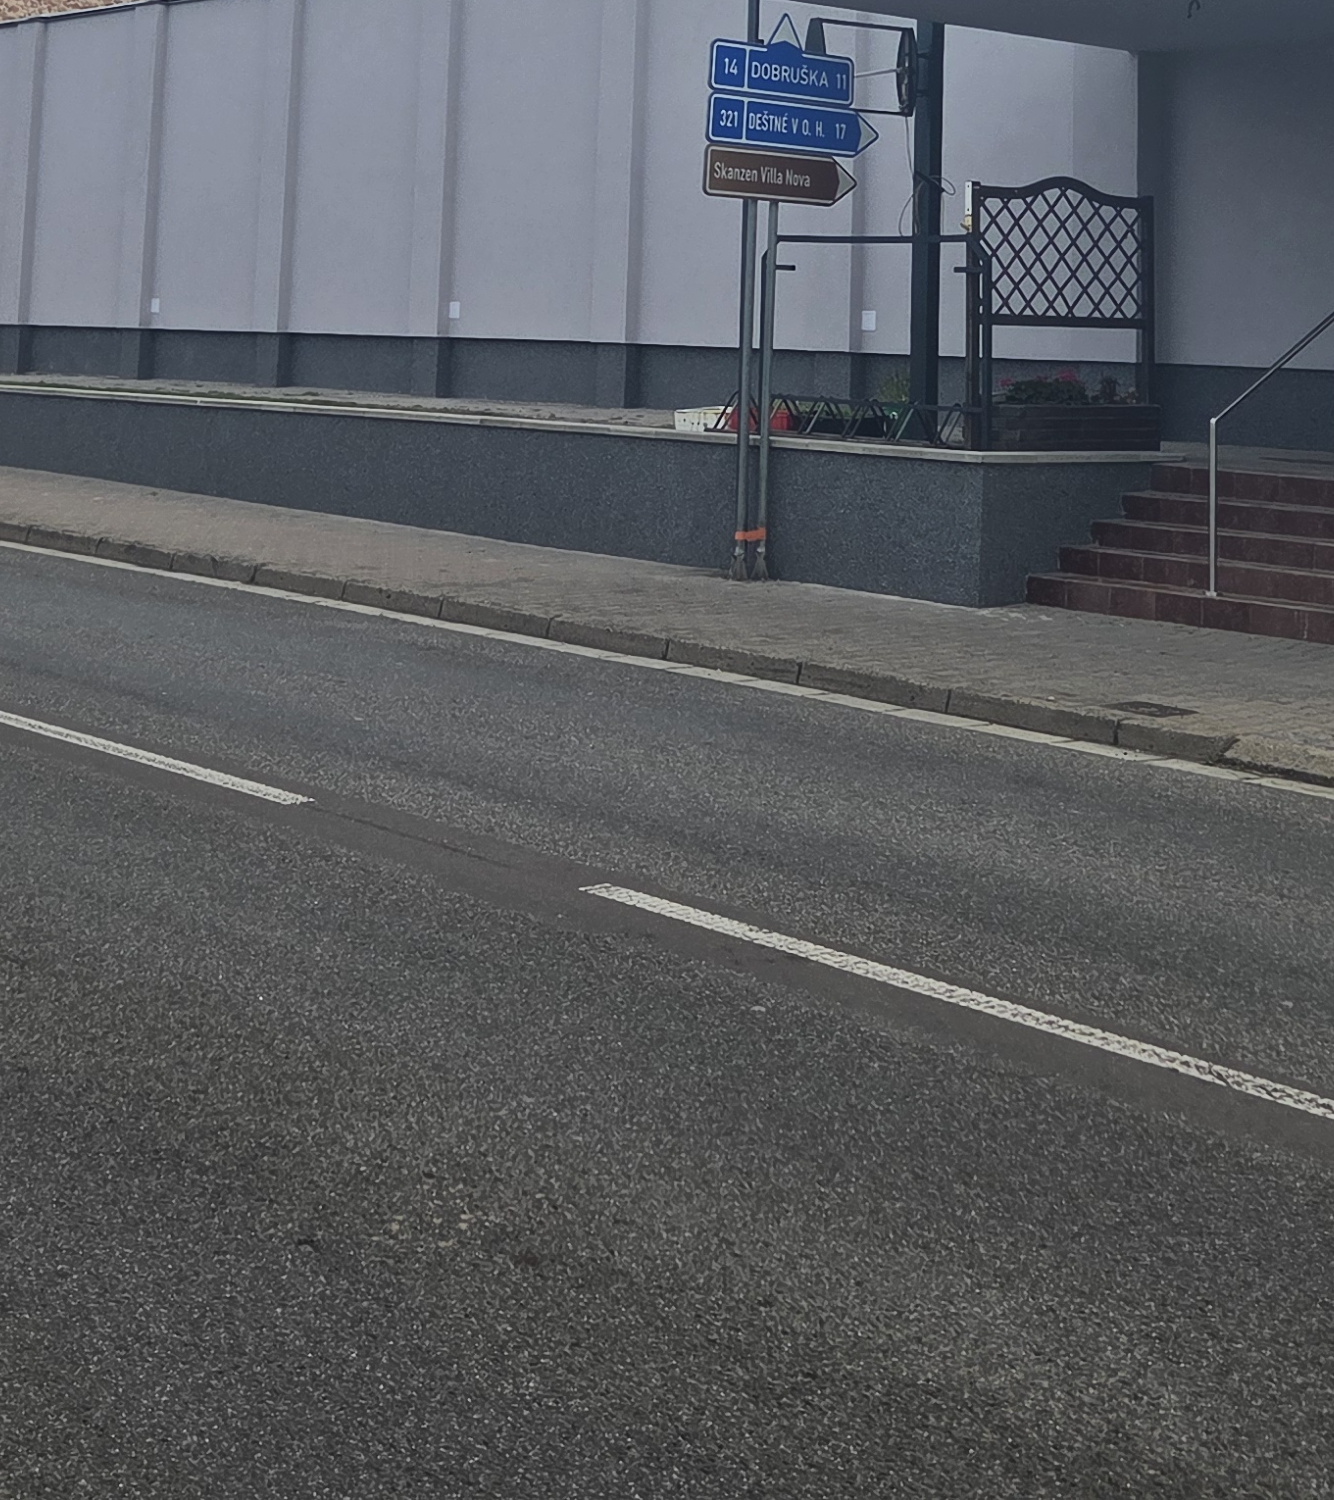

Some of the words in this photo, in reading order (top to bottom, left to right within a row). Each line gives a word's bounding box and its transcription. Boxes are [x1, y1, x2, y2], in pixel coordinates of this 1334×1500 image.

[724, 57, 738, 76] 14
[751, 61, 829, 88] DOBRUŠKA
[836, 73, 847, 90] 11
[719, 109, 739, 128] 321
[748, 110, 789, 134] DEŠTNÉ
[791, 117, 799, 135] V
[802, 119, 812, 136] O.
[815, 120, 825, 138] H.
[835, 123, 847, 140] 17
[713, 161, 758, 182] Skanzen
[760, 165, 784, 185] Villa
[785, 169, 811, 188] Nova
